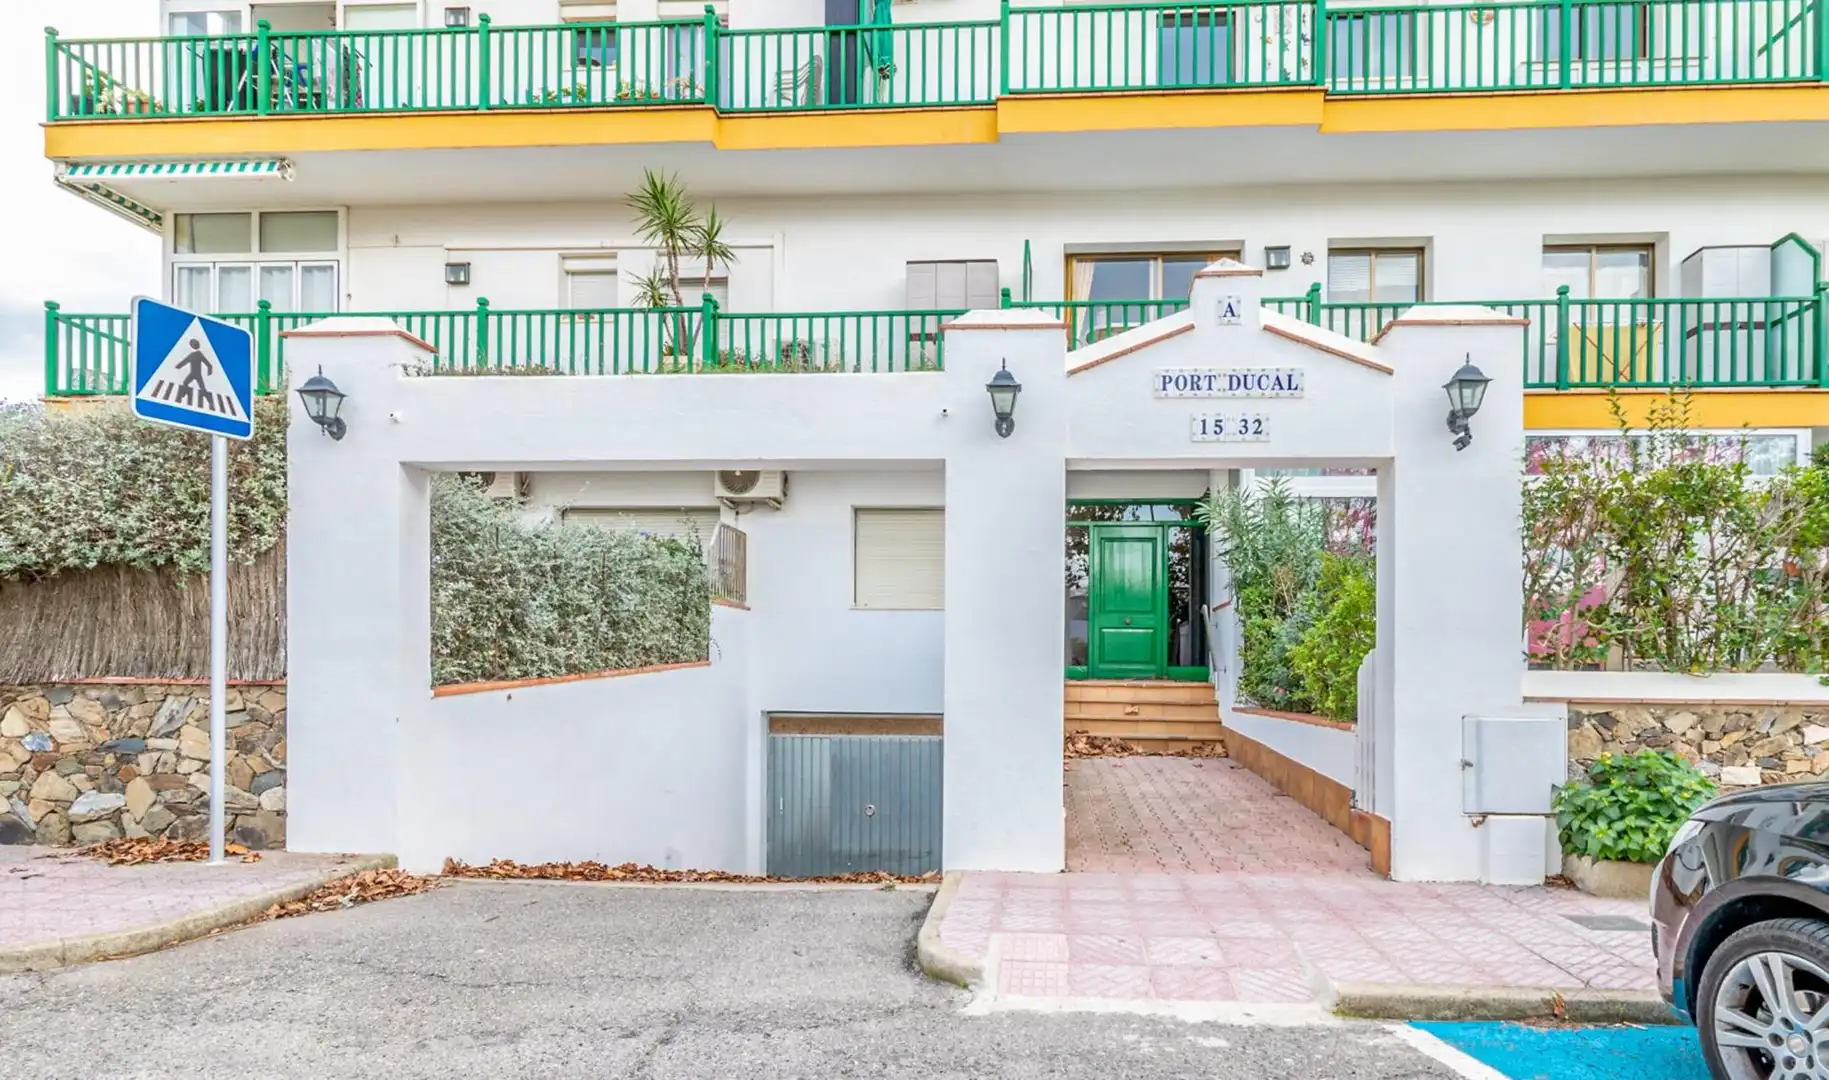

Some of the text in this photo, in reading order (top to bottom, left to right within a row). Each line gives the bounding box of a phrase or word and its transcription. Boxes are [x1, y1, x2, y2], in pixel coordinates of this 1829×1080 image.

[1223, 302, 1236, 317] A
[1161, 374, 1299, 391] PORT DUCAL
